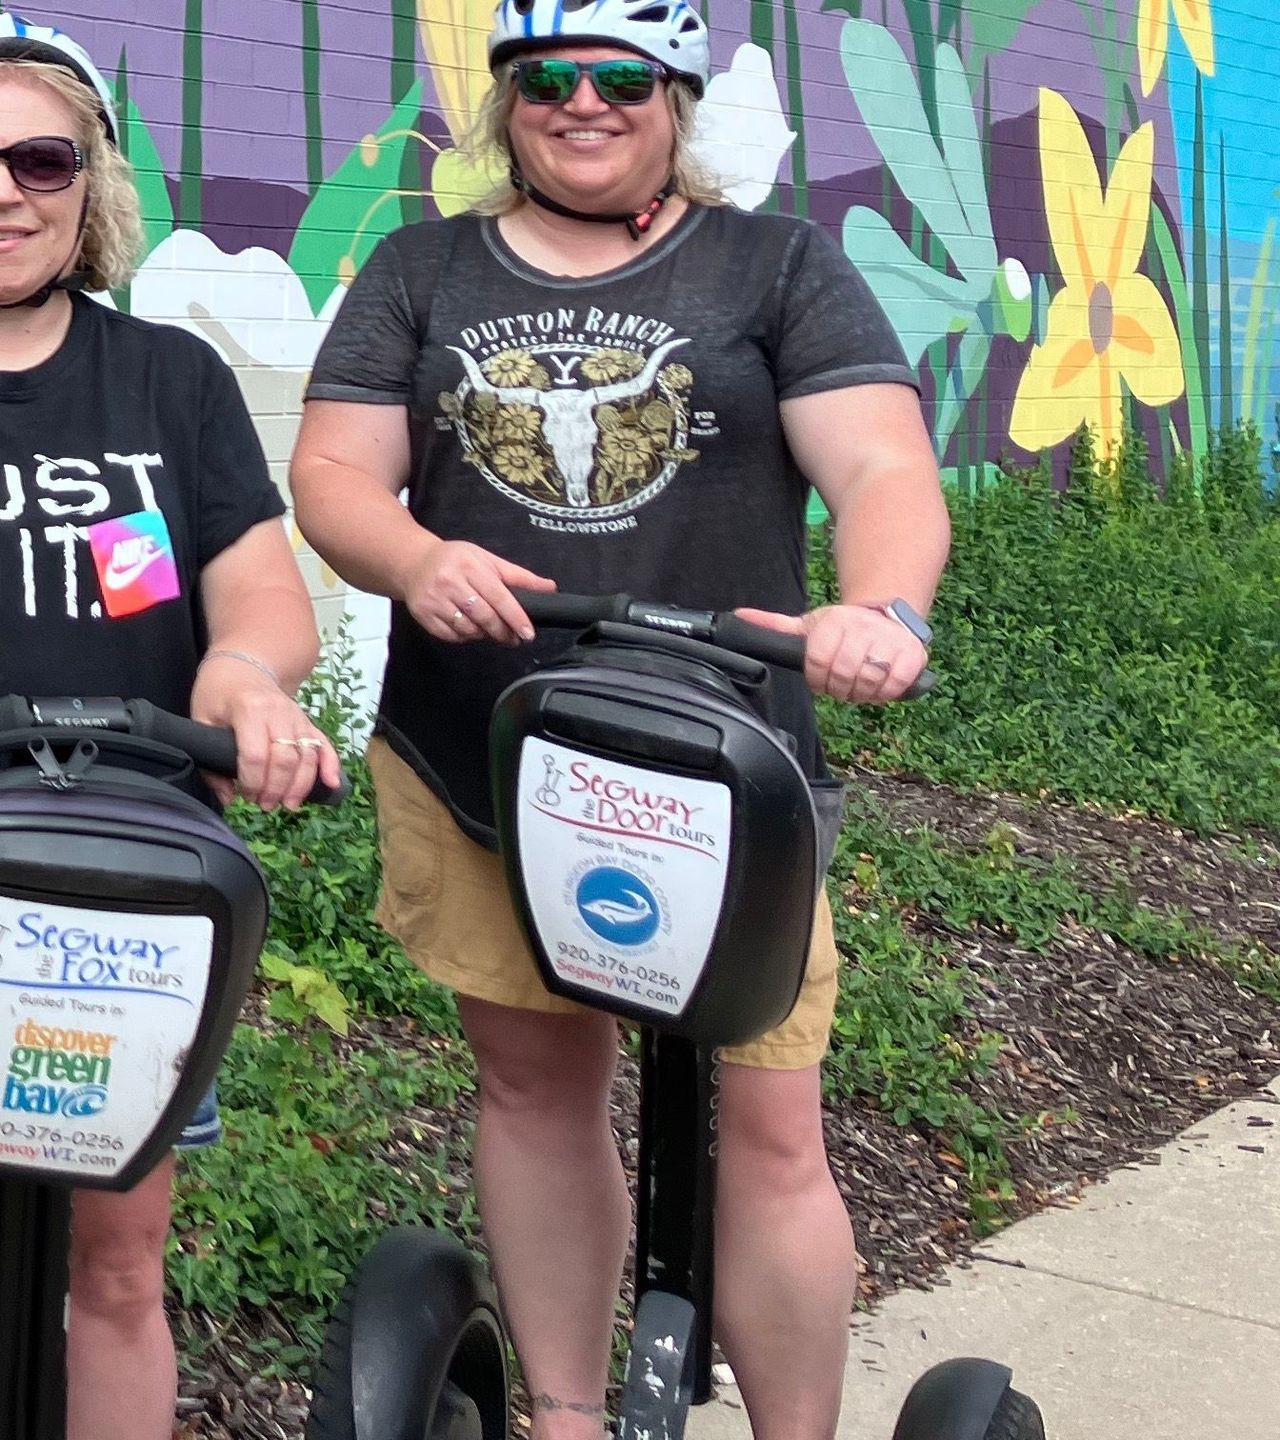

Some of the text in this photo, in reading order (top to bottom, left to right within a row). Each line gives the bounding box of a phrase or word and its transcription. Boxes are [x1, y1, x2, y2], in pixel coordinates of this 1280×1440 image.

[460, 306, 677, 351] DUTTON RANCH
[528, 513, 639, 535] YELLOWSTONE
[669, 823, 717, 848] tours
[127, 966, 184, 988] tours
[555, 958, 679, 1007] SegwayWI.com
[557, 941, 681, 990] 920-376-0256
[18, 993, 65, 1009] Guided
[69, 998, 106, 1014] Tours
[14, 1017, 118, 1055] discover
[8, 1045, 113, 1086] green
[1, 1072, 67, 1116] bay
